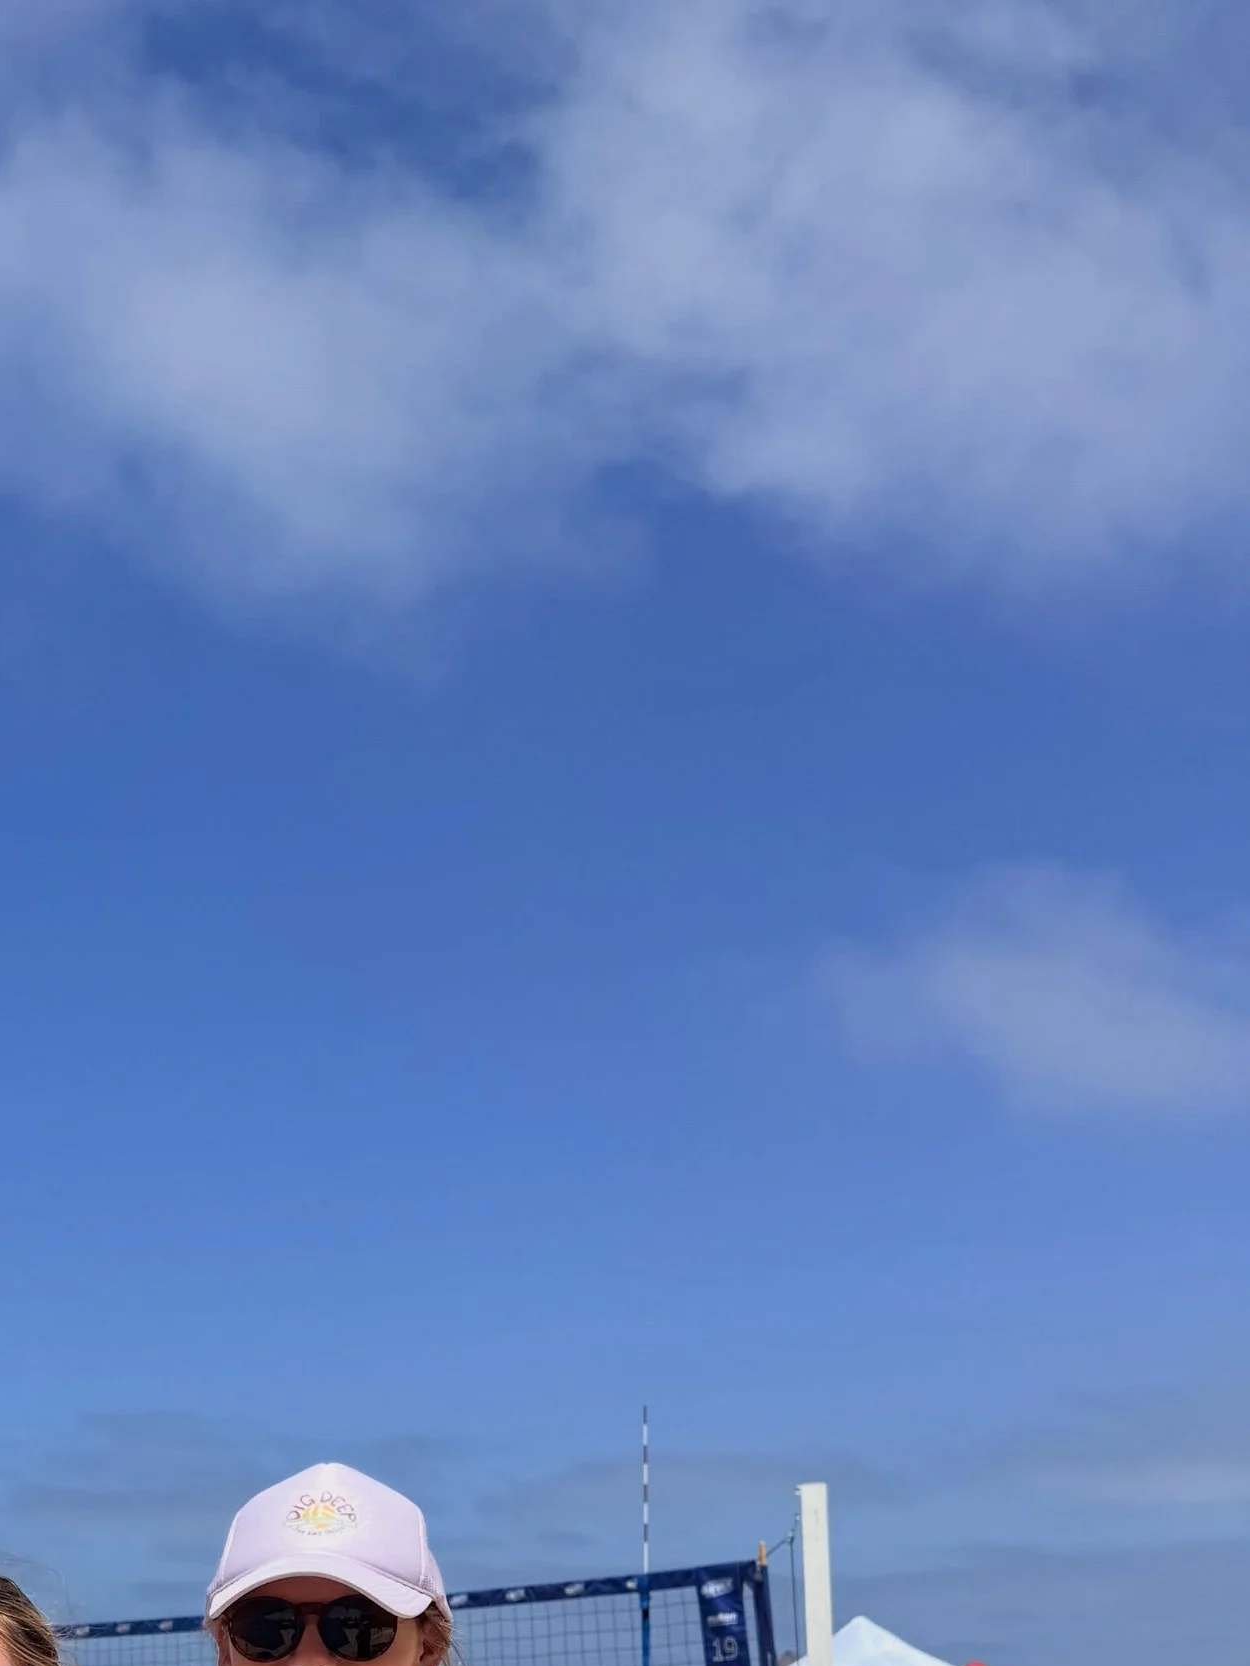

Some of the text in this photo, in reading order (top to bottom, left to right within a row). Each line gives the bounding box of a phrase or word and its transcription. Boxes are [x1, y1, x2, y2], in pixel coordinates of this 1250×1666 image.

[286, 1490, 357, 1522] DIG DEEP
[712, 1635, 739, 1662] 19
